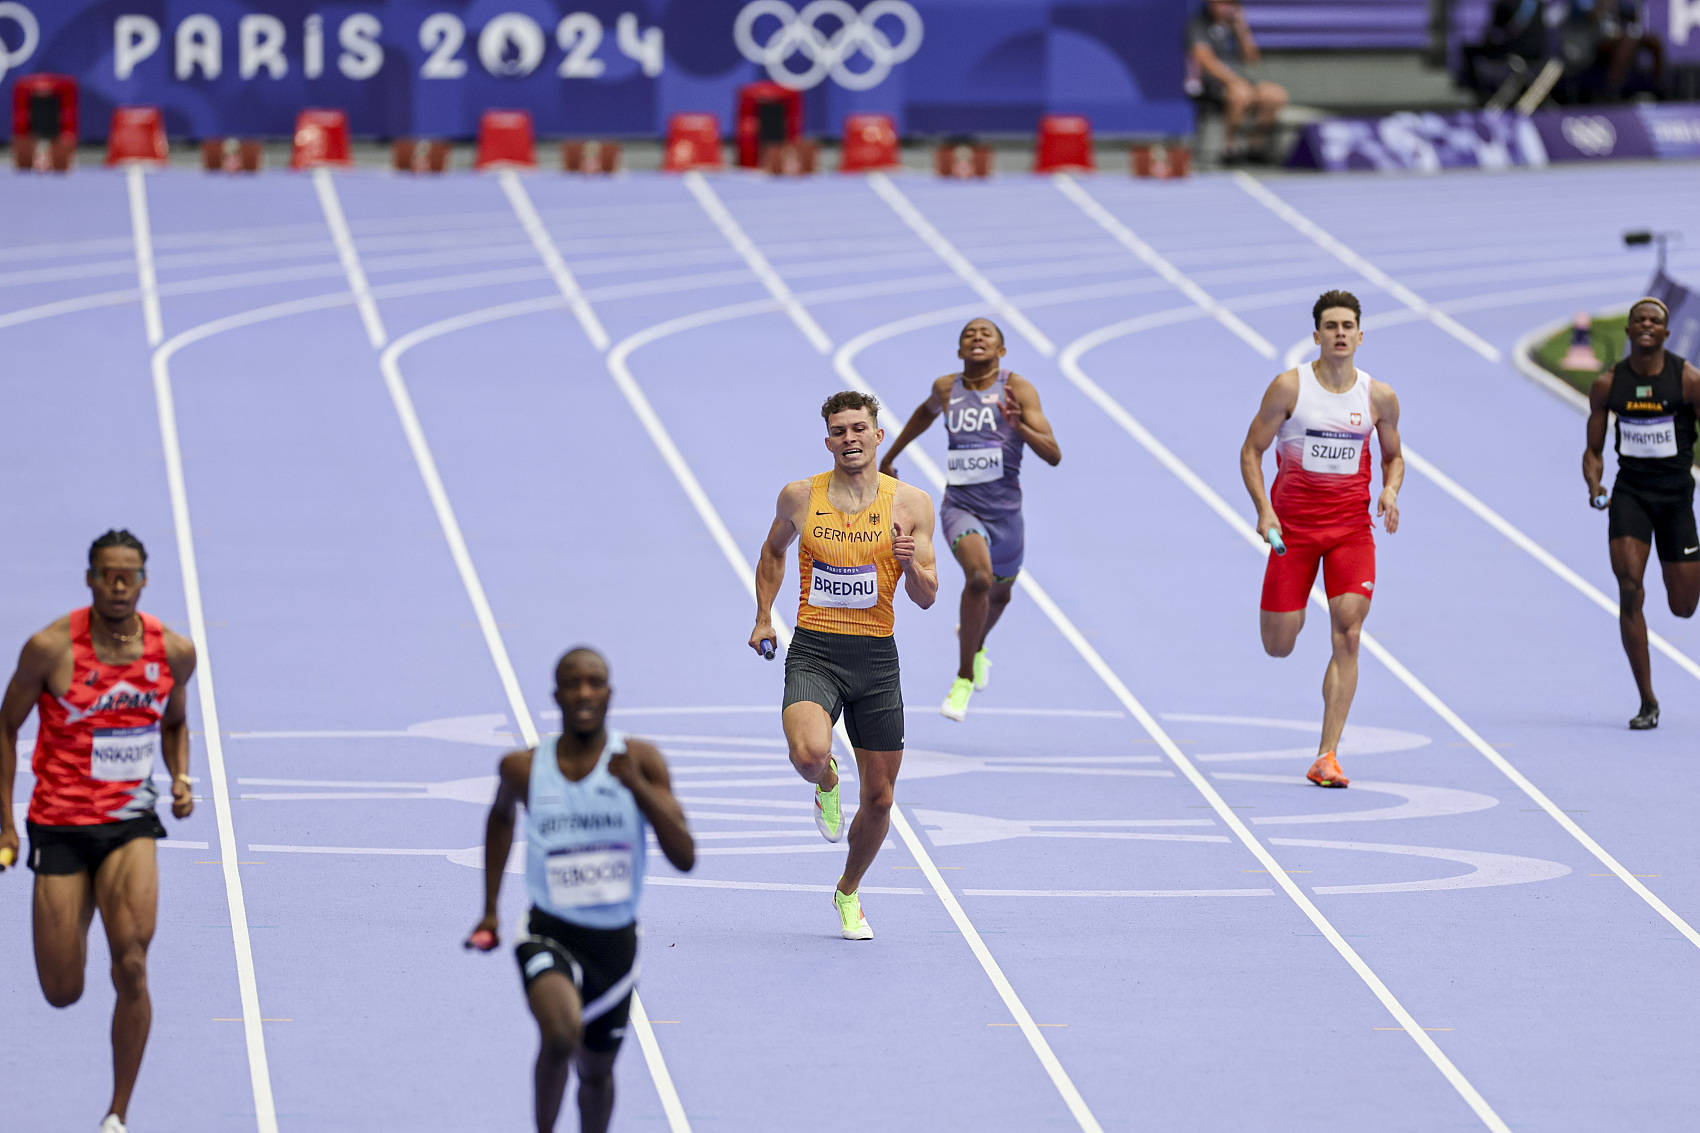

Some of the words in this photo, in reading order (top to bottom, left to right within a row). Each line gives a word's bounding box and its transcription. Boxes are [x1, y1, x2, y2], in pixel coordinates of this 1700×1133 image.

[418, 12, 663, 79] 2024
[948, 406, 997, 433] USA
[1311, 444, 1355, 460] SZWED
[948, 456, 998, 471] WILSON
[812, 525, 882, 543] GERMANY
[814, 576, 874, 596] BREDAU
[89, 691, 157, 711] JAPAN
